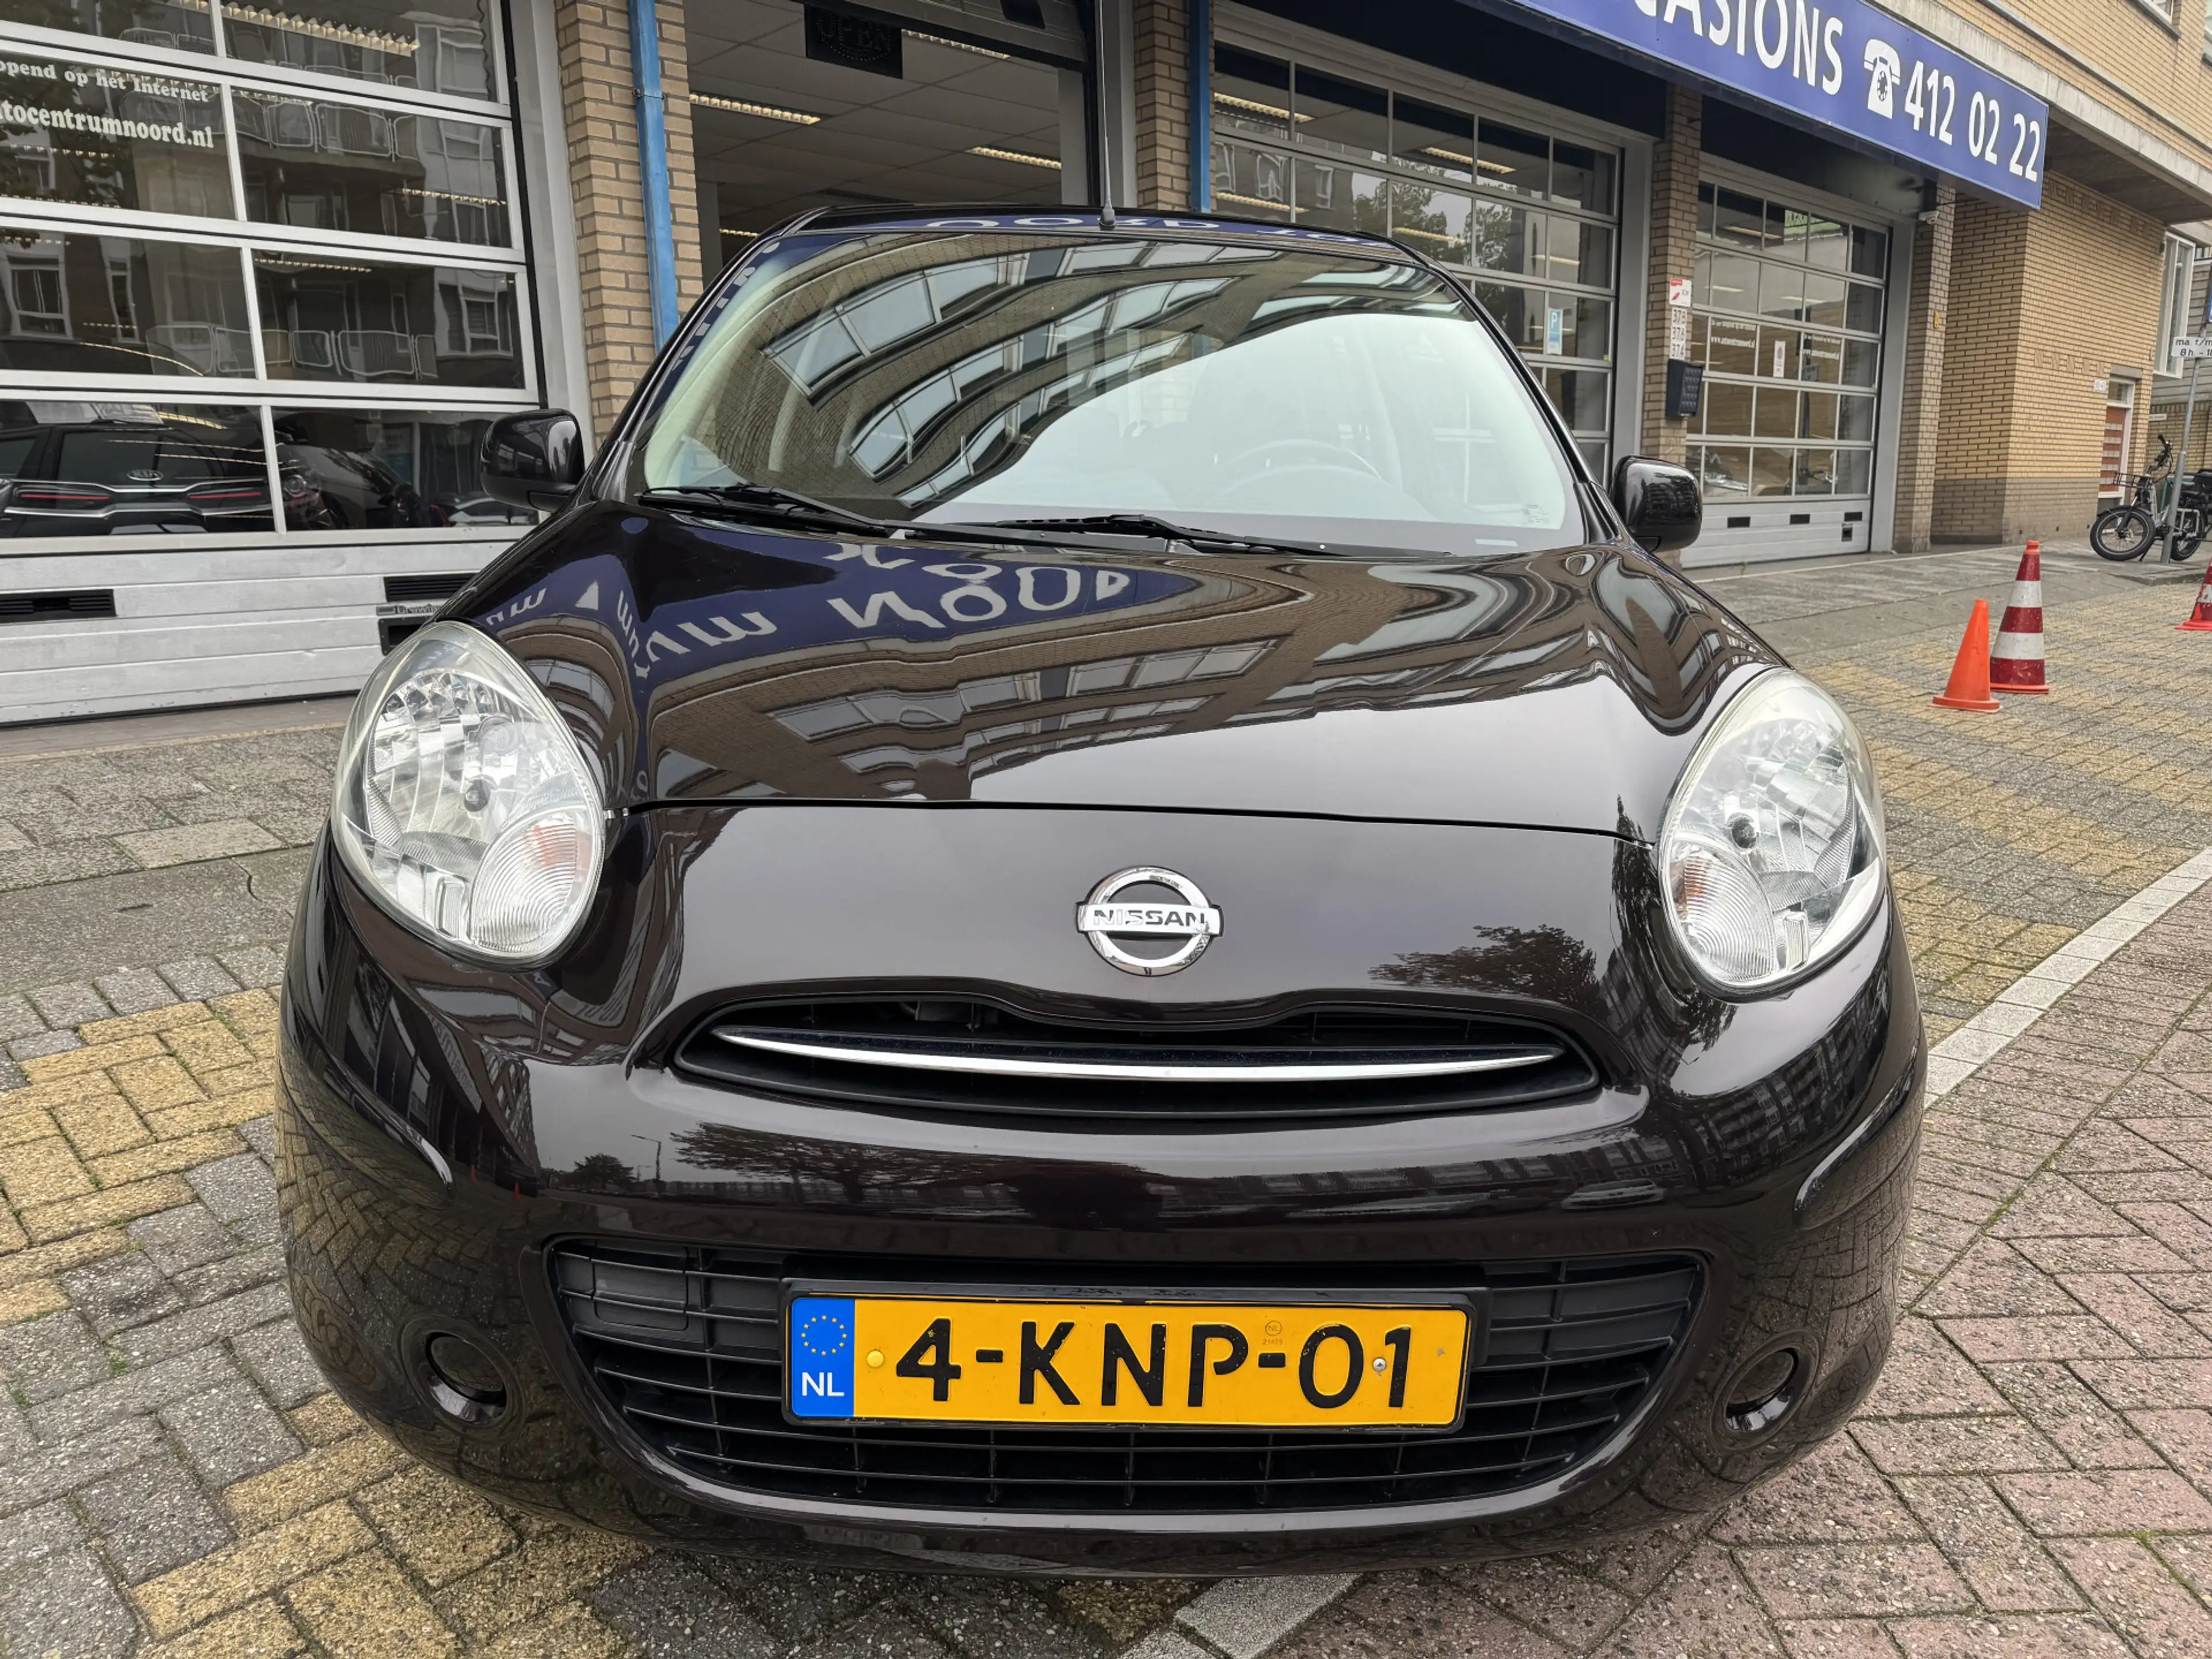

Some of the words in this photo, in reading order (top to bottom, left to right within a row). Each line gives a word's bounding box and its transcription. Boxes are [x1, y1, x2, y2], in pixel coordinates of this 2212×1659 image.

[65, 70, 88, 86] op
[96, 74, 126, 89] het
[134, 79, 208, 101] Internet
[1634, 0, 1843, 95] SIONS
[1904, 60, 1955, 146] 412
[1968, 91, 2000, 165] 02
[2009, 113, 2040, 183] 22
[1093, 908, 1205, 927] NISSAN
[896, 1317, 1411, 1409] 4-KNP-01
[801, 1372, 845, 1396] NL
